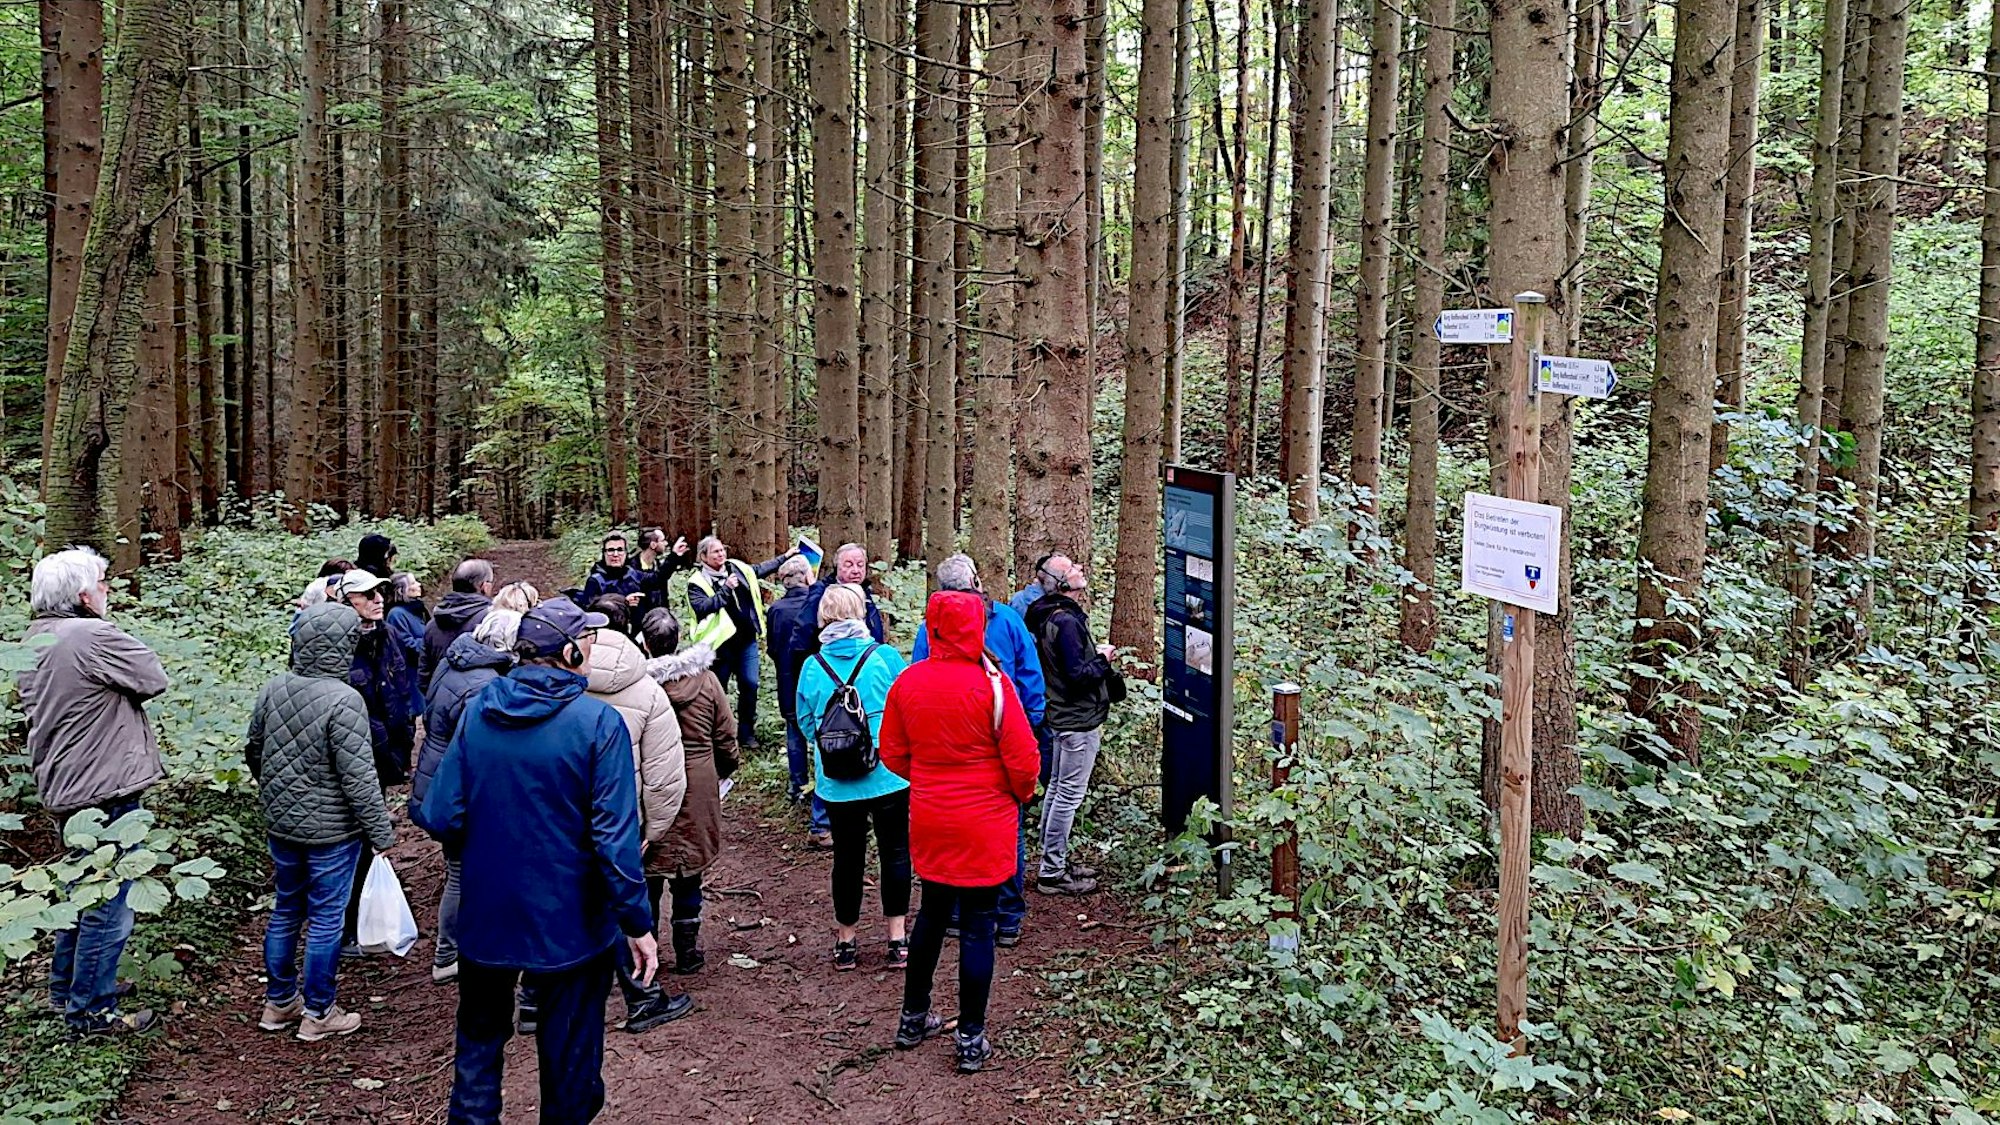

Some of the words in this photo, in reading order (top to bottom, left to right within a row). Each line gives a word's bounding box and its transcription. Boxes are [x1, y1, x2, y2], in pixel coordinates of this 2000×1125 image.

[1474, 510, 1485, 519] Das
[1486, 512, 1509, 523] Betreten
[1510, 517, 1519, 525] der
[1517, 530, 1545, 540] verboten!
